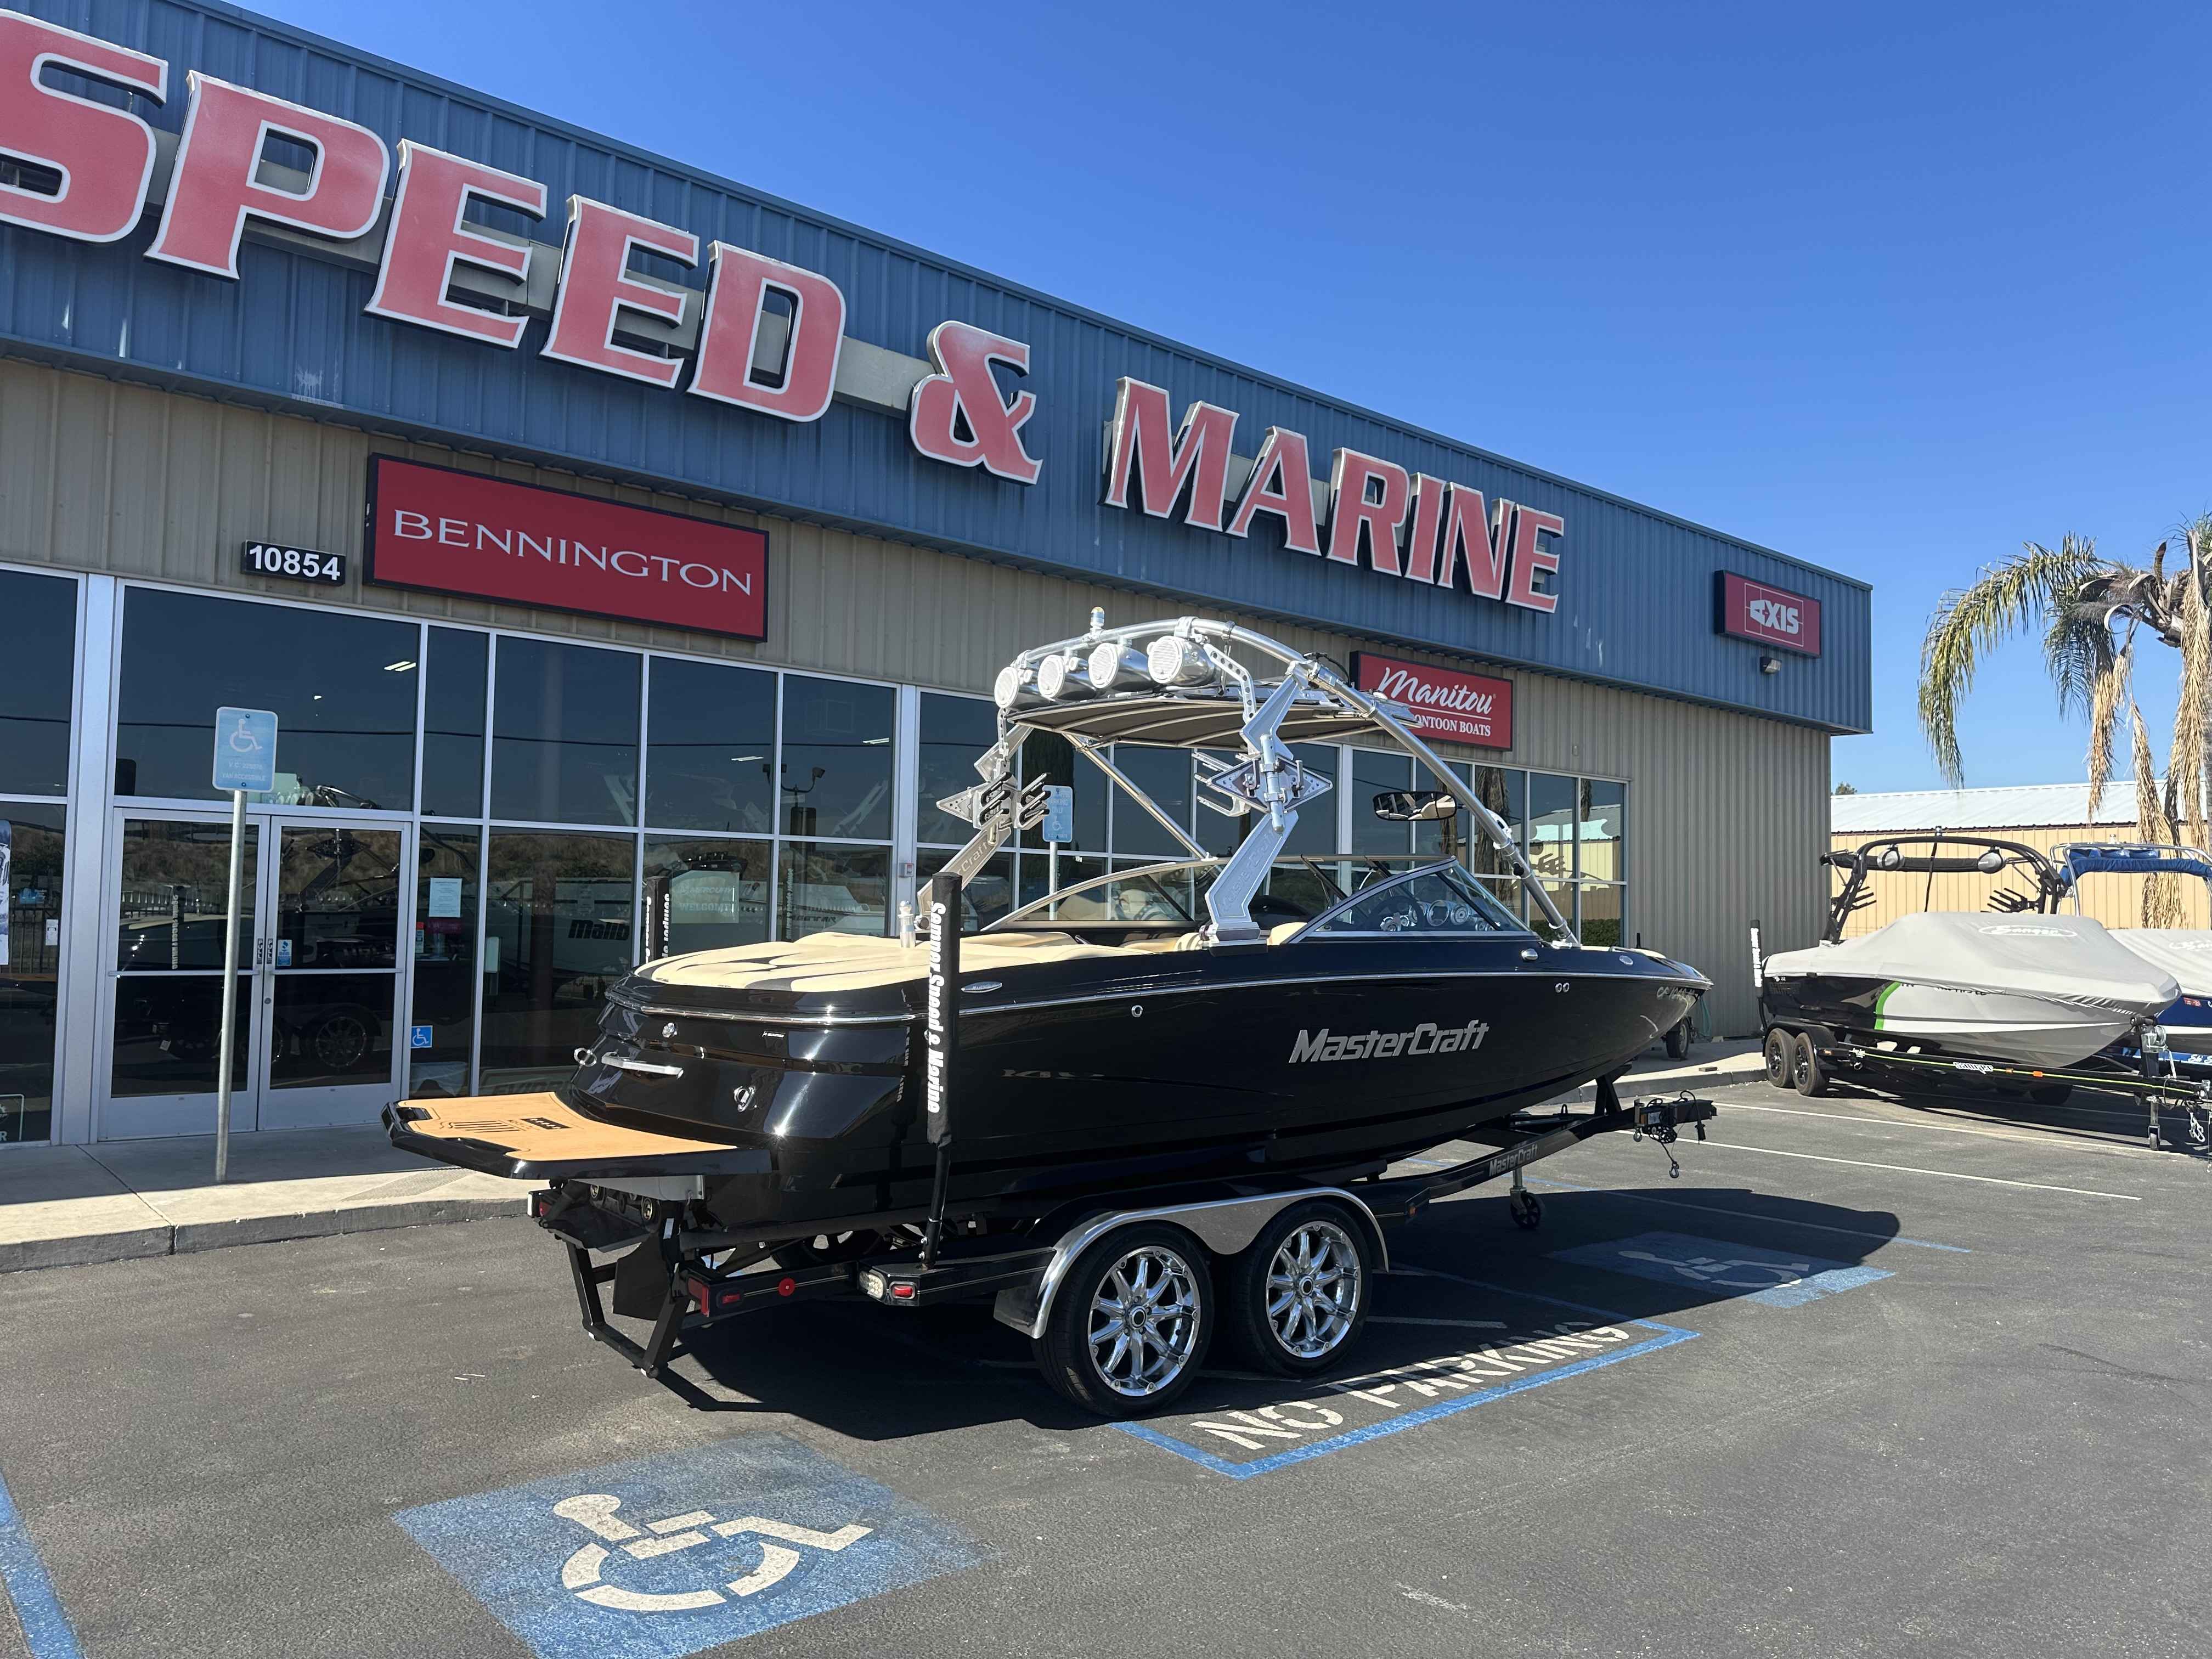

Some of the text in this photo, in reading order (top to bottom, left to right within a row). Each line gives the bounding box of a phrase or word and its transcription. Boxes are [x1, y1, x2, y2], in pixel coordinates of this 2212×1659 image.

[0, 8, 1564, 613] SPEED & MARINE
[249, 545, 341, 580] 10854
[394, 510, 752, 596] BENNINGTON
[1750, 600, 1799, 634] AXIS
[1378, 667, 1492, 714] Manitou
[1414, 714, 1491, 737] ONTOON BOATS
[568, 919, 630, 941] Malib
[1289, 1019, 1489, 1063] MasterCraft
[927, 1047, 944, 1114] Marine
[1489, 1143, 1538, 1177] MasterCraft
[1190, 1321, 1630, 1450] NO PARKING
